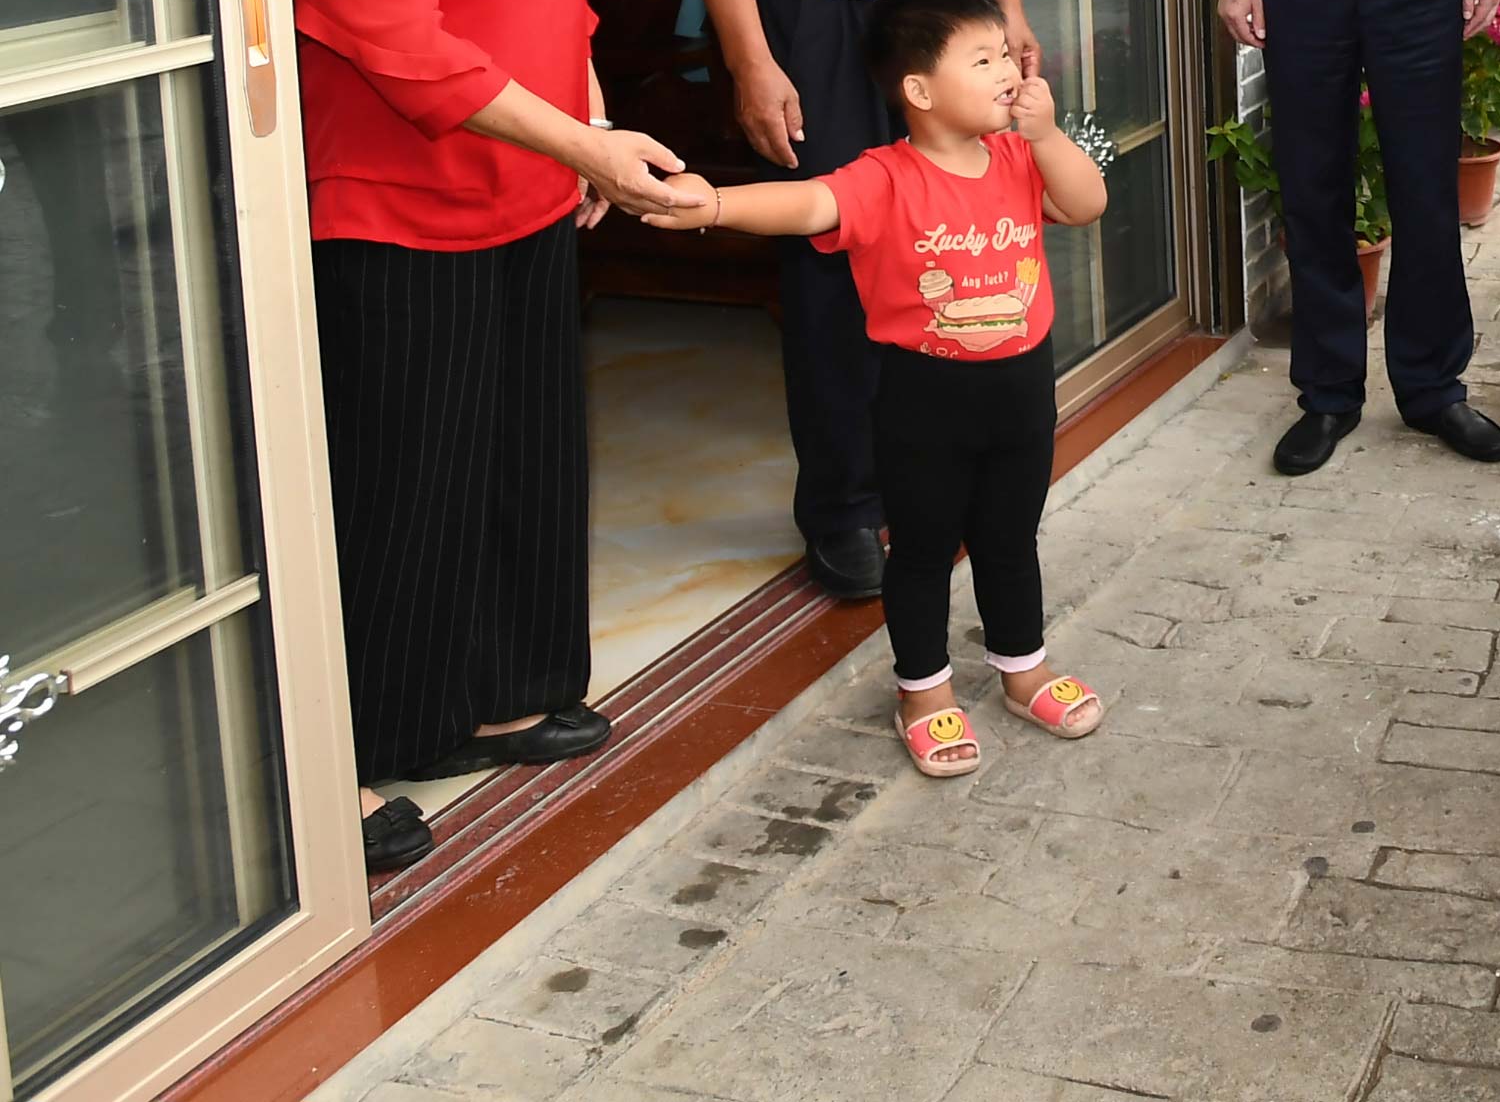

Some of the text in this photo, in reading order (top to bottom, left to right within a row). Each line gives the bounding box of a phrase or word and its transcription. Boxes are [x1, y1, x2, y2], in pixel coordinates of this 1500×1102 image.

[914, 217, 1037, 256] Lucky Days
[961, 271, 1009, 289] Any luck?
